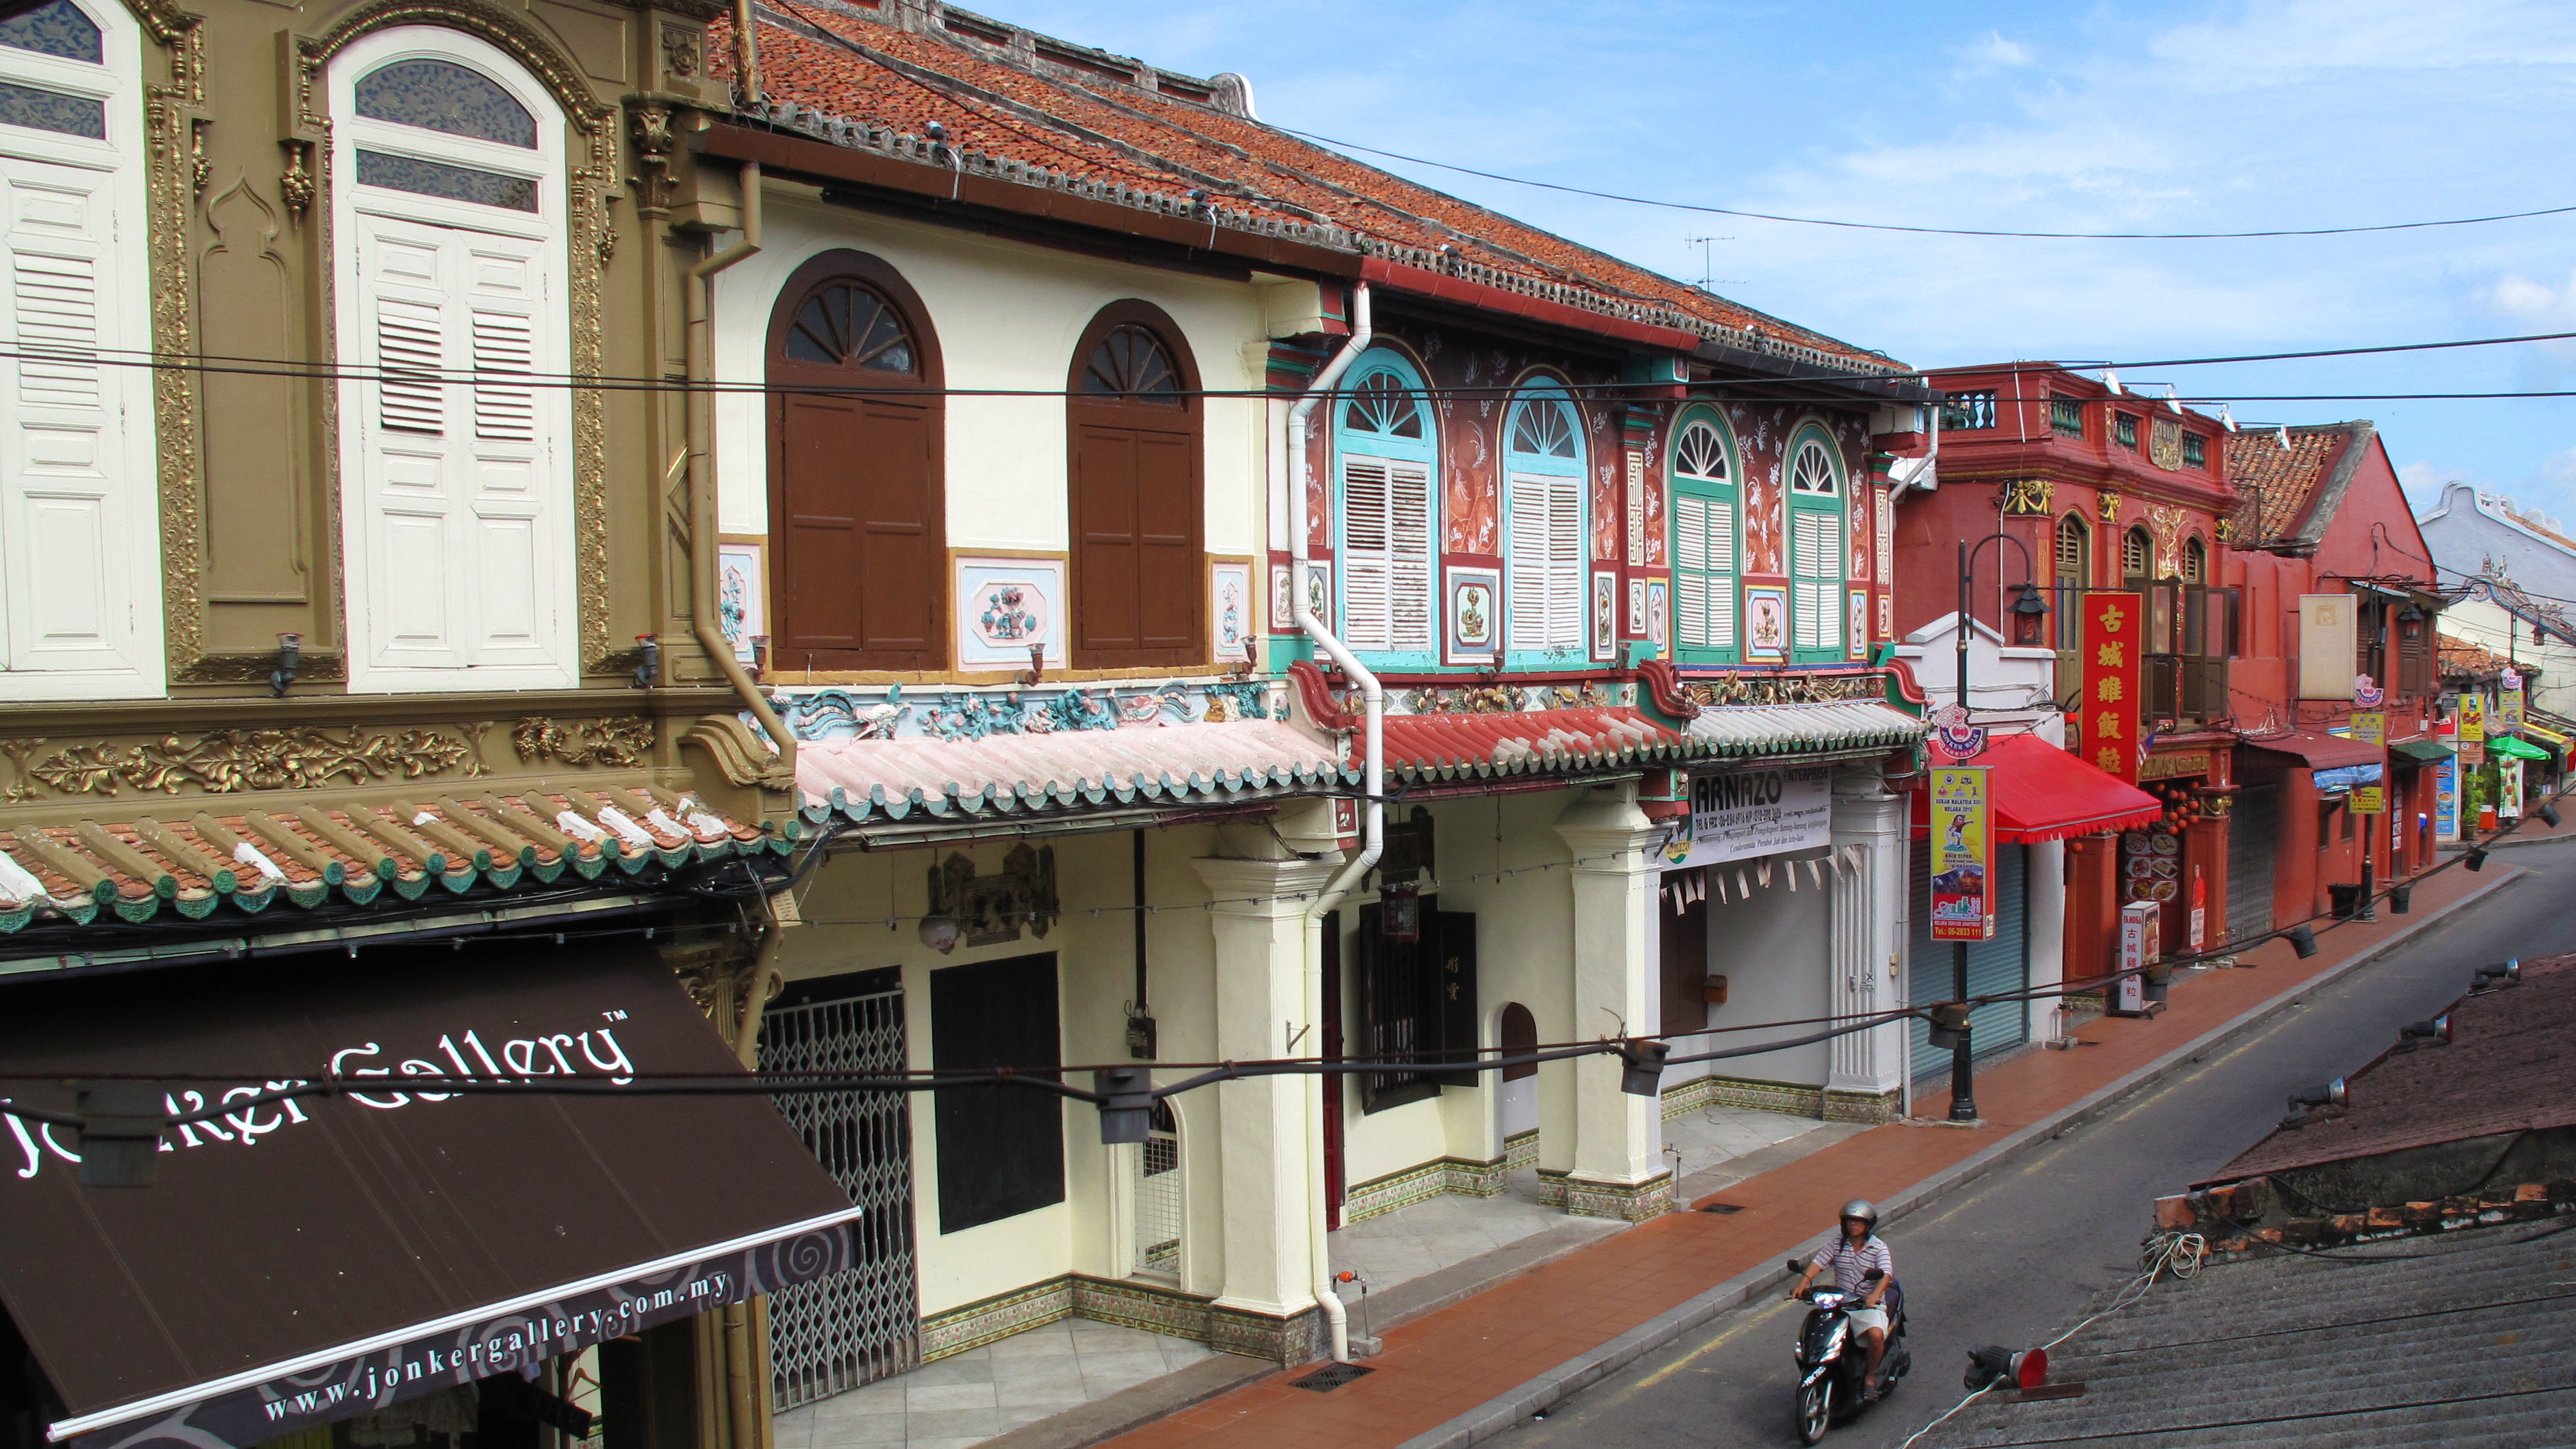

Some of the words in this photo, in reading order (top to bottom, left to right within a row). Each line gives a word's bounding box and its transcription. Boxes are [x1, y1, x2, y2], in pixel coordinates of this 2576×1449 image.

[1695, 770, 1782, 814] ARNAZO
[1783, 766, 1829, 783] ENTERPRISE
[1971, 929, 1982, 937] 111
[330, 1029, 634, 1108] Gallery
[265, 1272, 728, 1421] www.jonkergallery.com.my
